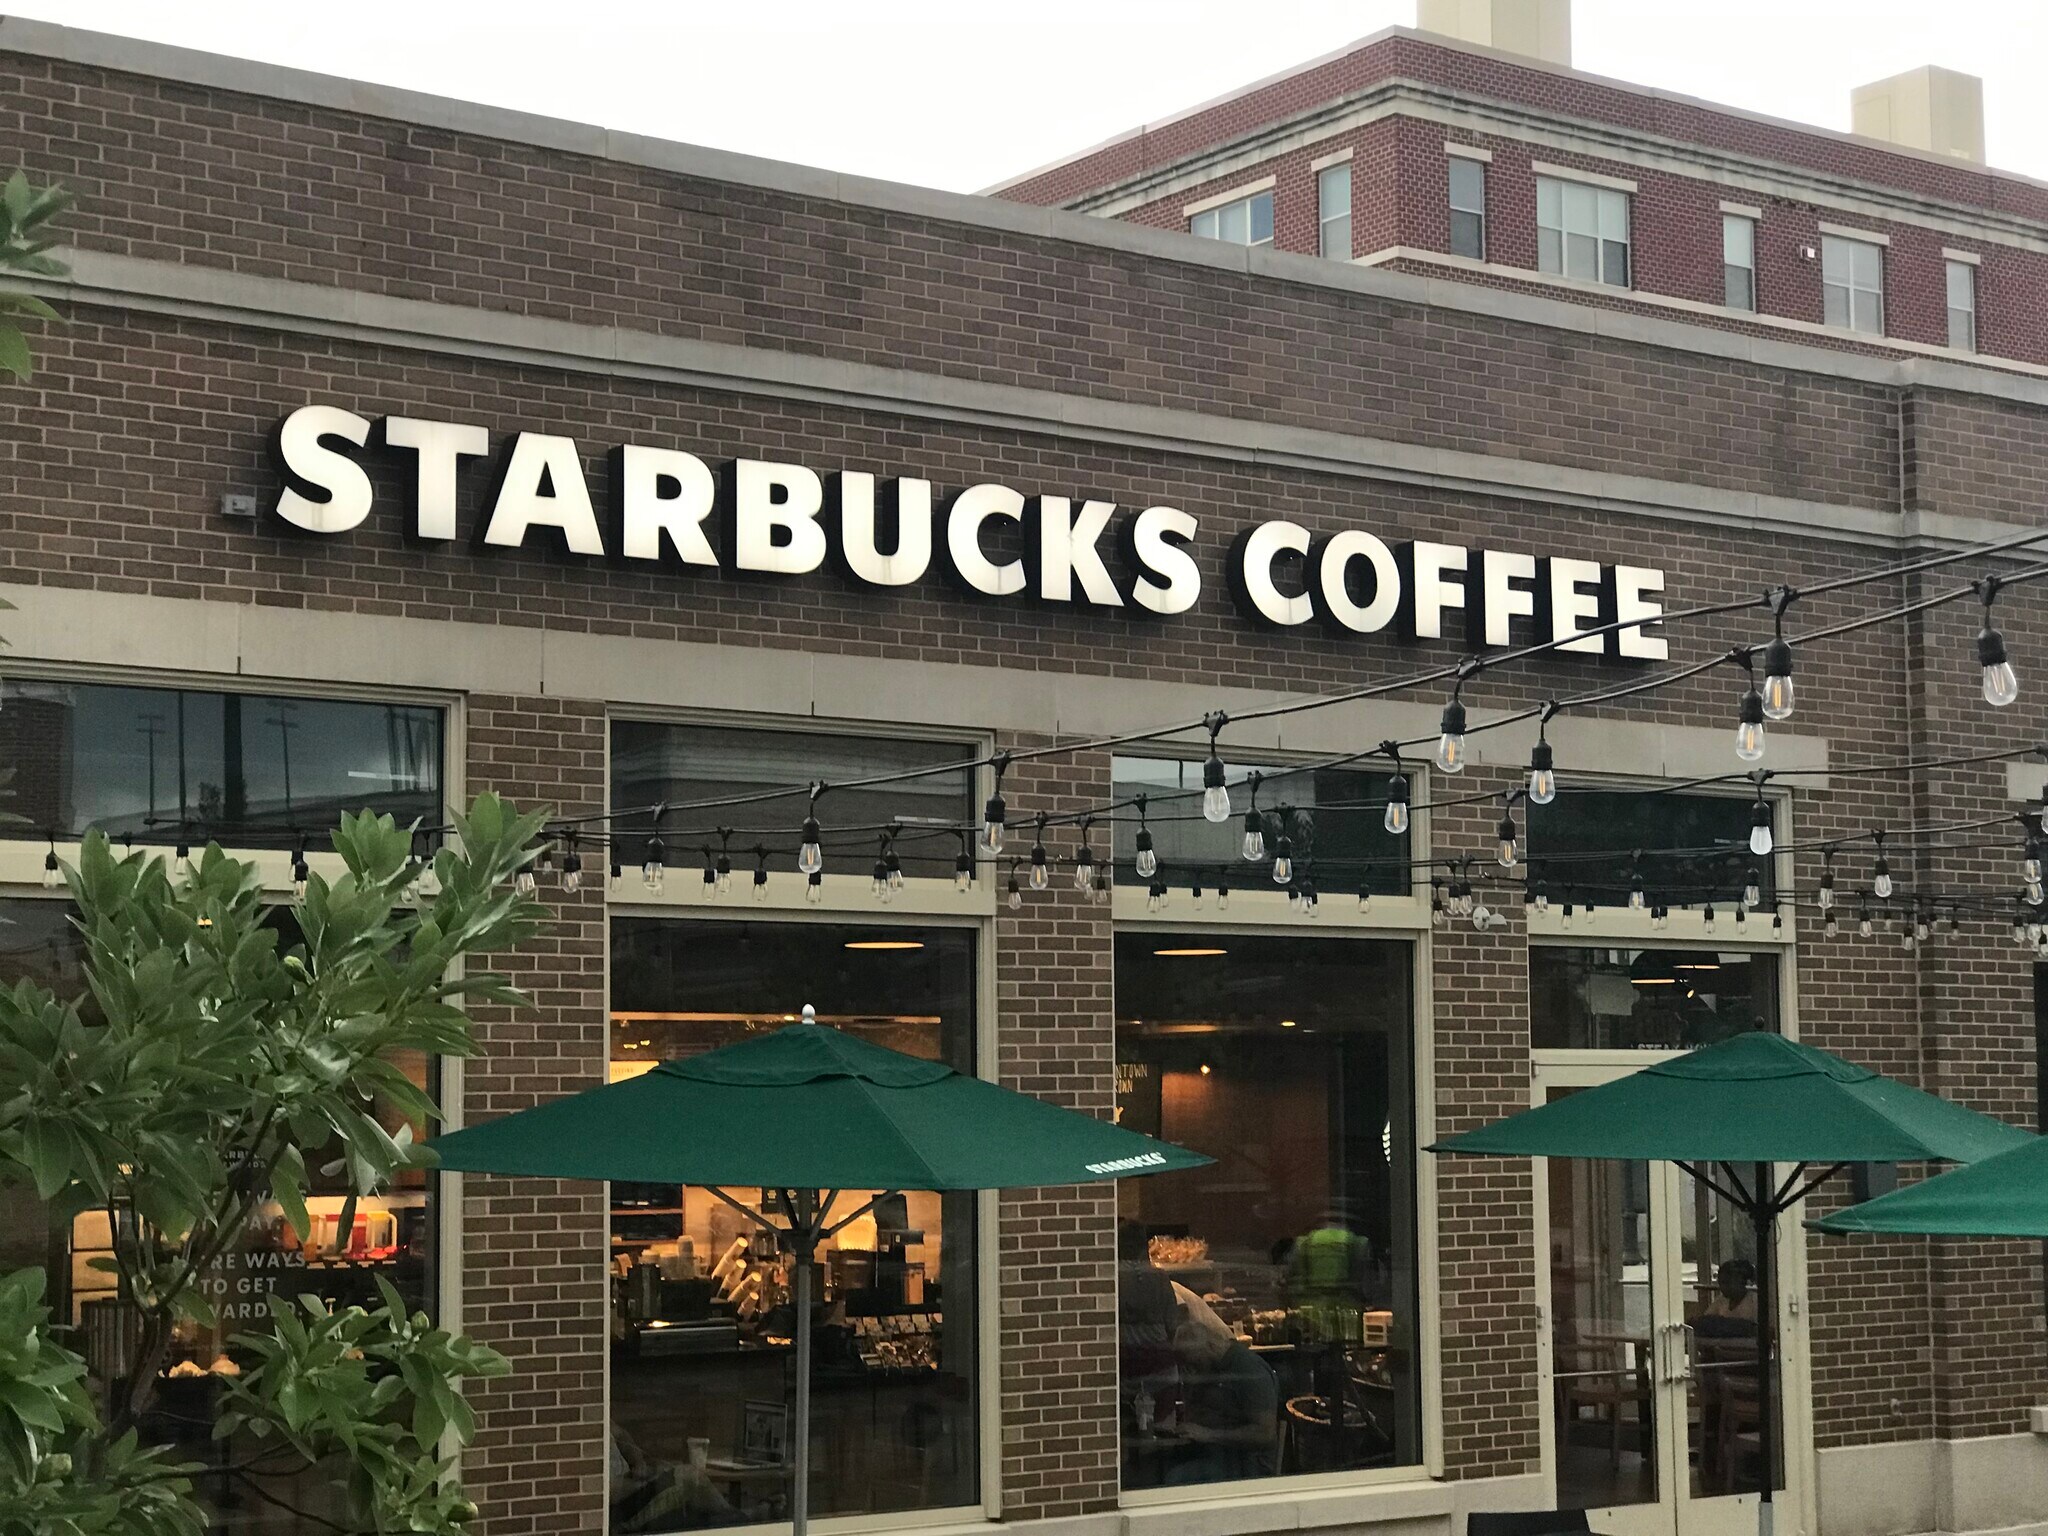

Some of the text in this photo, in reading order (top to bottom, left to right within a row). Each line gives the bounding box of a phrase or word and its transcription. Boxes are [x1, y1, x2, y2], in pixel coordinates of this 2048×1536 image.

[274, 404, 1670, 661] STARBUCKS COFFEE
[244, 1251, 306, 1269] WAYS
[201, 1276, 277, 1295] TO GET
